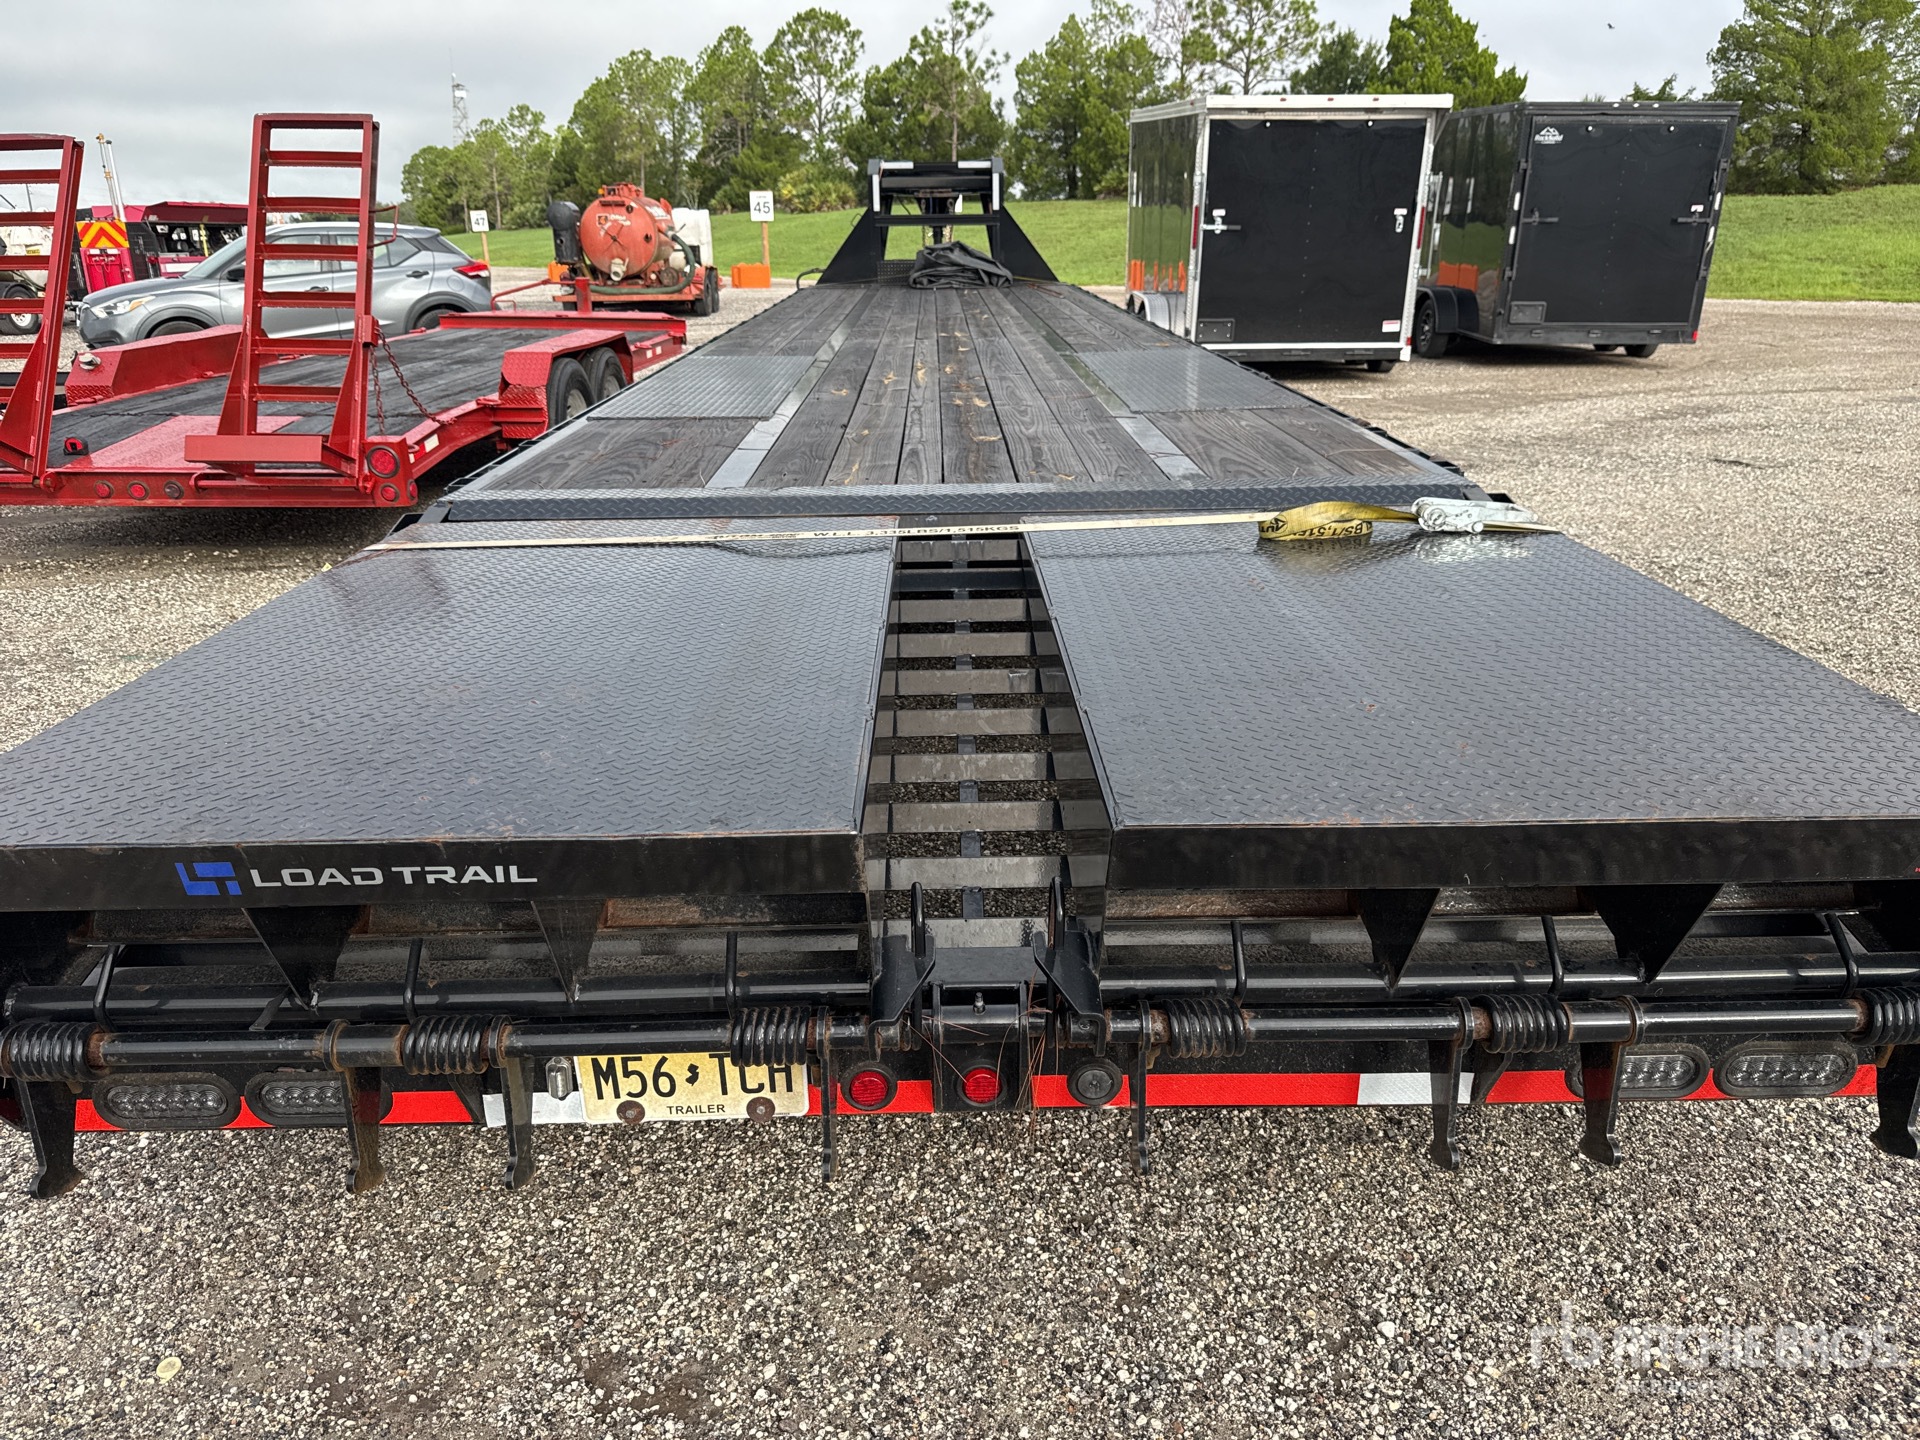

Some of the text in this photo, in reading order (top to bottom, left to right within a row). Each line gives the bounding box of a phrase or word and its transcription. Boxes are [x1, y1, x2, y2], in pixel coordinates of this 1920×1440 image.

[753, 201, 771, 214] 45
[474, 217, 485, 226] 47
[250, 867, 384, 887] LOAD
[391, 865, 538, 884] TRAIL
[591, 1055, 677, 1100] M56
[667, 1104, 726, 1115] TRAILER
